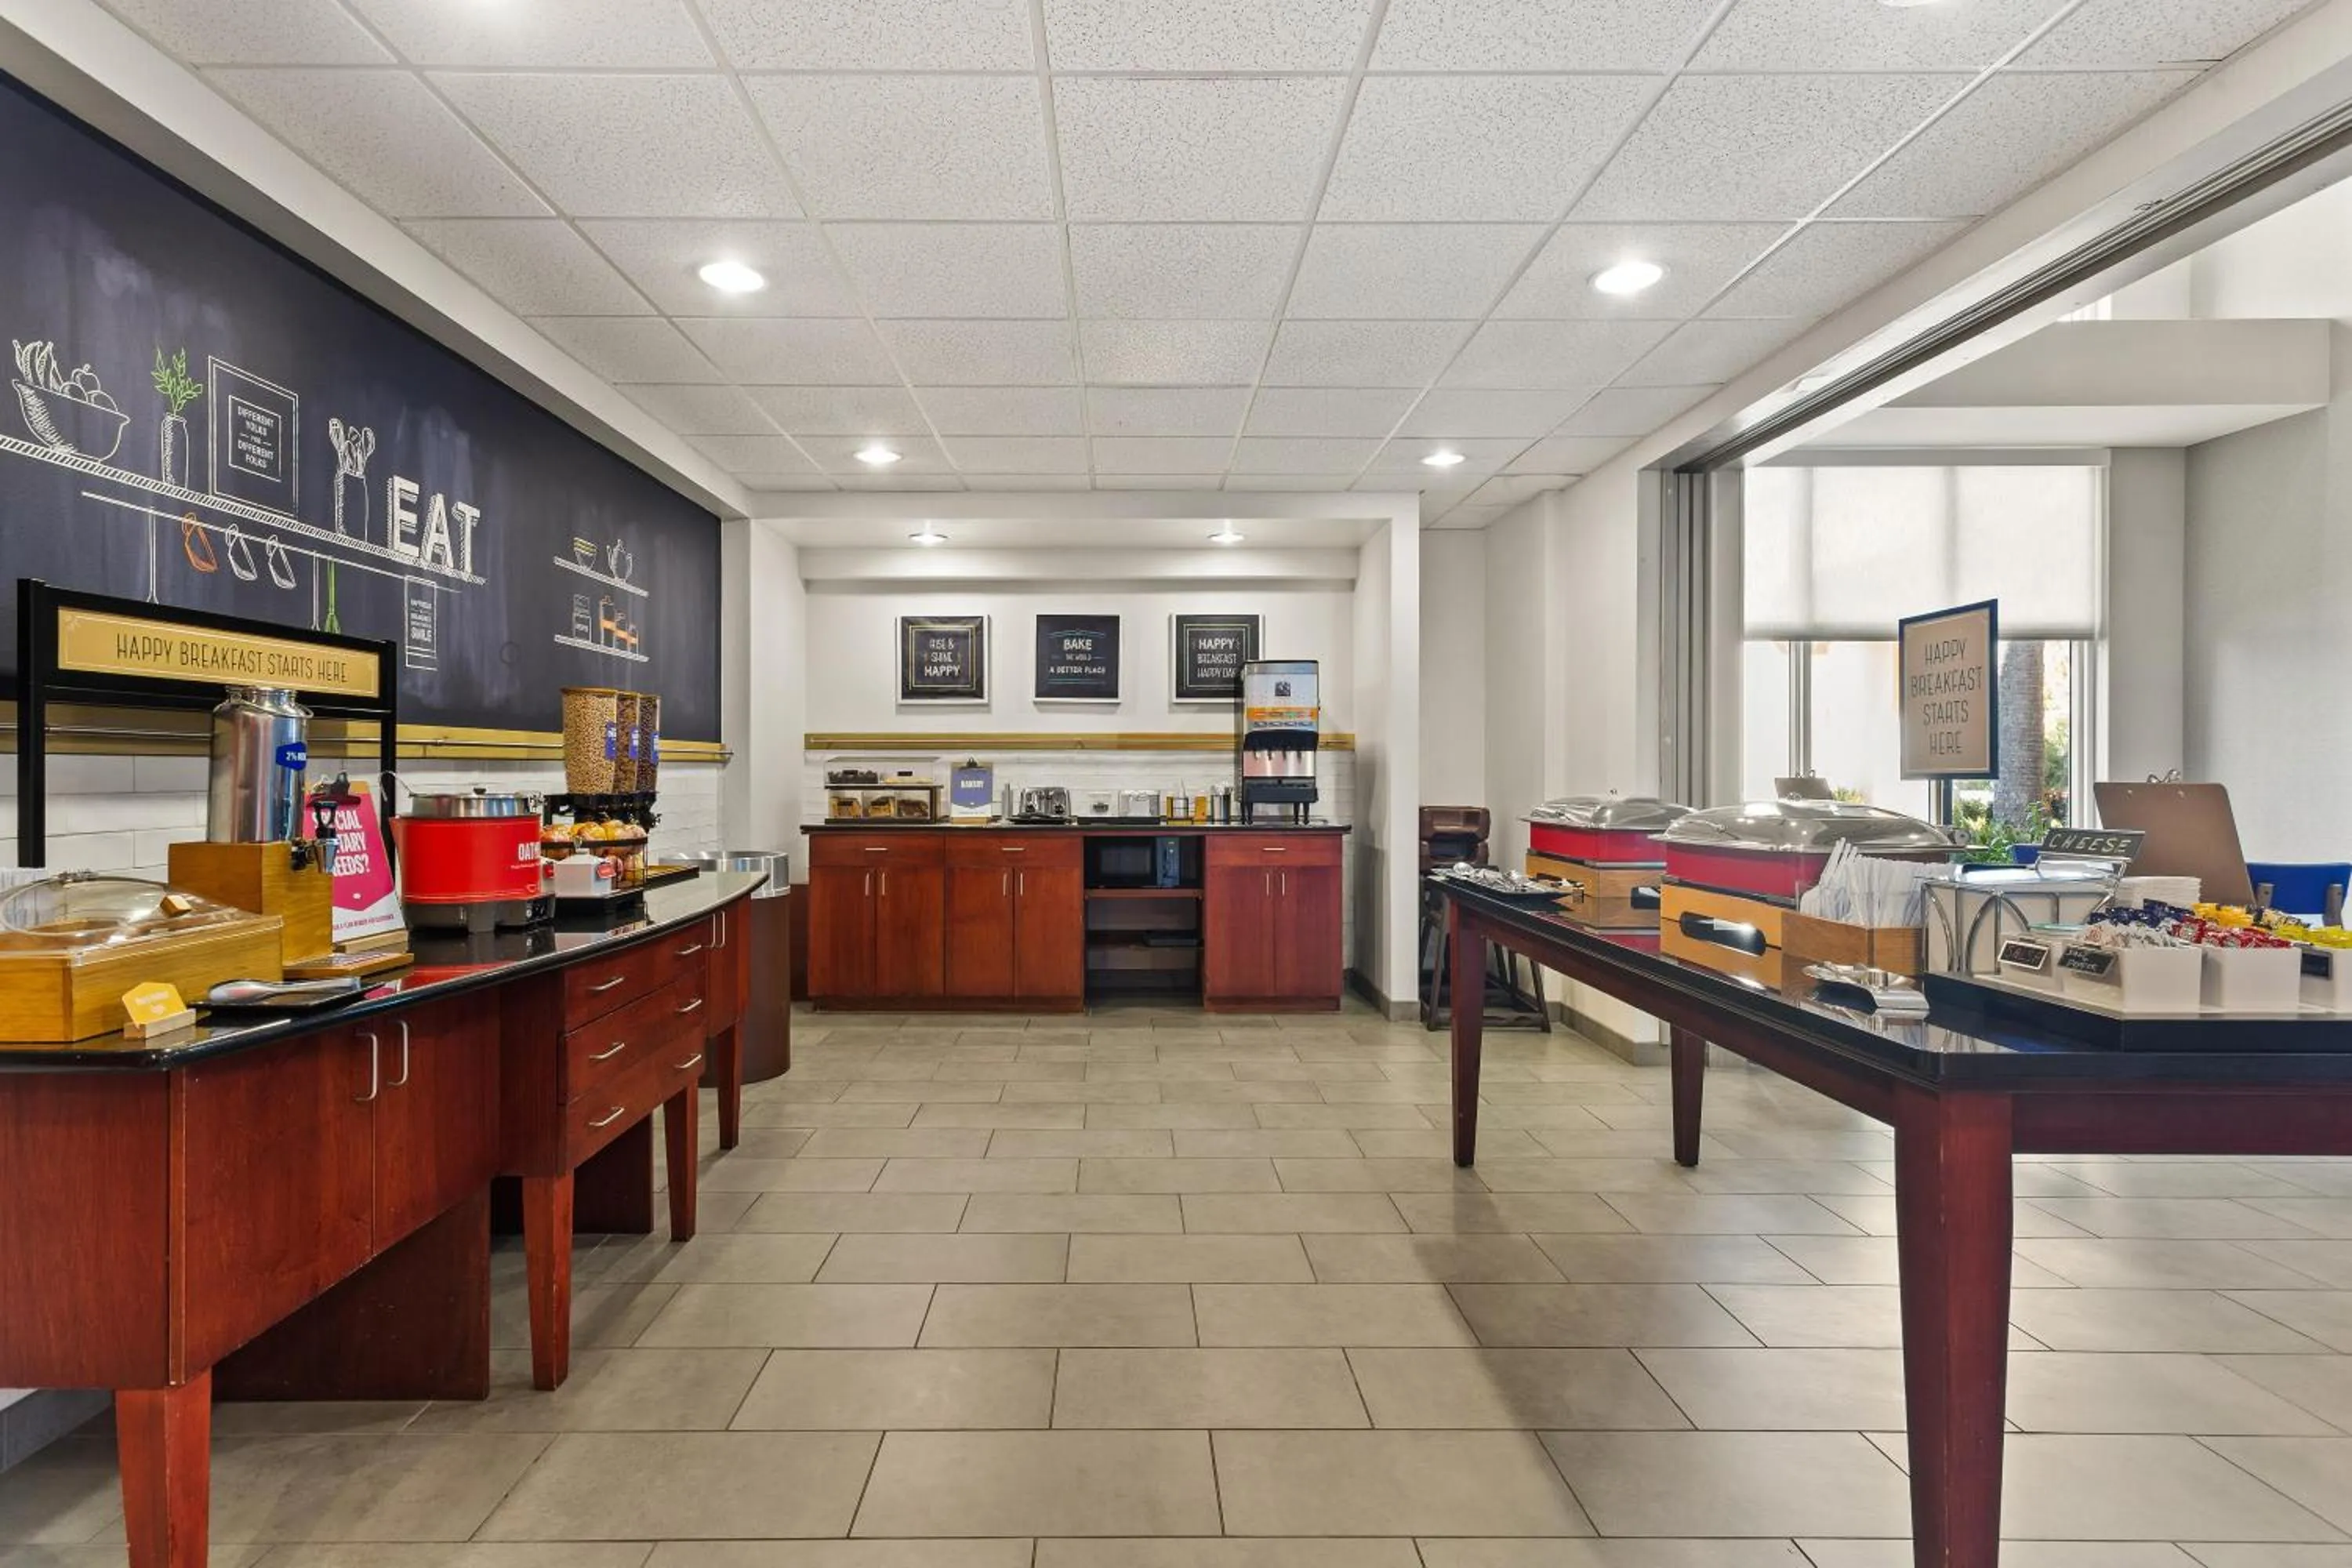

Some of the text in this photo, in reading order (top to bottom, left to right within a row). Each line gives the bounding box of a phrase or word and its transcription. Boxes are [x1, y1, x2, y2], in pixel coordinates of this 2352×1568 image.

[238, 406, 273, 427] DIFFERENT
[238, 440, 274, 460] DIFFERENT
[387, 475, 480, 574] EAT
[1063, 638, 1092, 651] BAKE
[1199, 637, 1235, 649] HAPPY
[1925, 637, 1968, 666] HAPPY
[117, 633, 348, 683] HAPPY BREAKFAST STARTS HERE
[1197, 654, 1236, 664] BREAKFAST
[924, 665, 960, 677] HAPPY
[1197, 667, 1221, 677] HAPPY
[1911, 666, 1983, 698] BREAKFAST
[1923, 699, 1969, 726] STARTS
[1929, 731, 1962, 755] HERE
[286, 751, 297, 761] 2%
[2049, 833, 2132, 853] CHEESE
